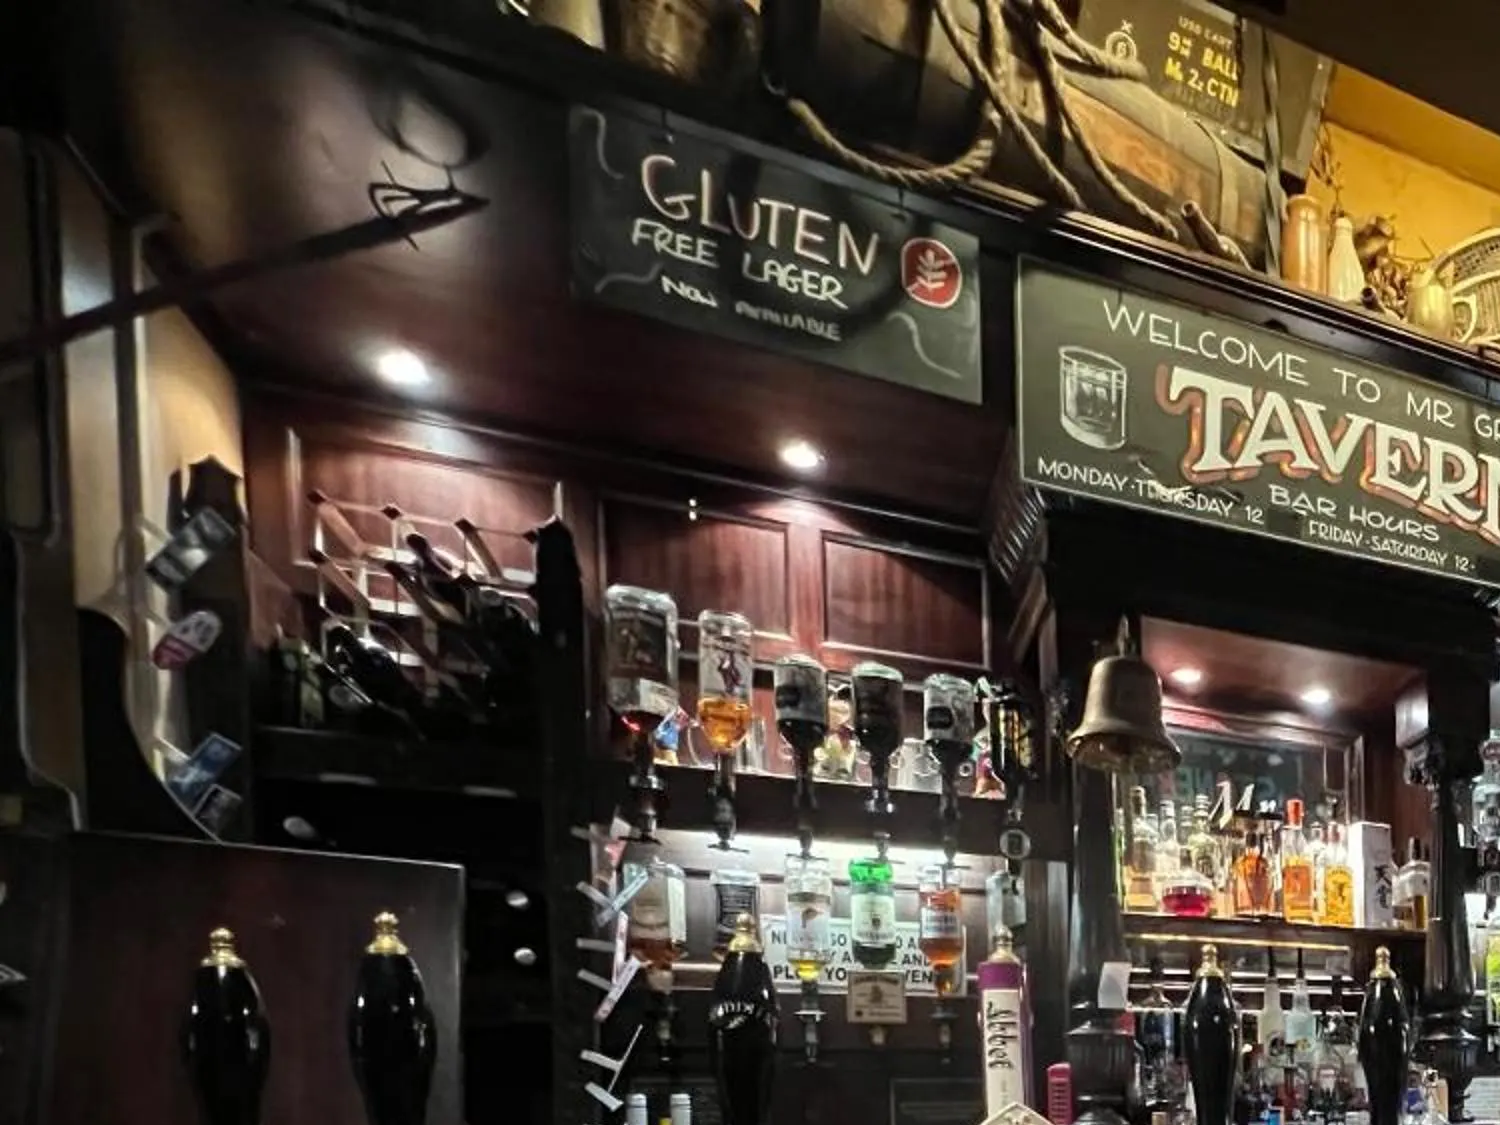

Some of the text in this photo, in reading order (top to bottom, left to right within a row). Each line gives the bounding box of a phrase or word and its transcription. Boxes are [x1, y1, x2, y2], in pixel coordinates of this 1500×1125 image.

[641, 154, 879, 276] GLUTEN
[632, 218, 848, 309] FREE LAGER
[1103, 299, 1311, 386] WELCOME
[1333, 366, 1381, 403] TO
[1406, 393, 1455, 429] MR
[1037, 456, 1129, 492] MONDAY
[1244, 505, 1264, 525] 12
[1268, 484, 1440, 542] BAR HOURS
[1308, 520, 1362, 549] FRIDAY
[1370, 536, 1448, 566] SATURDAY
